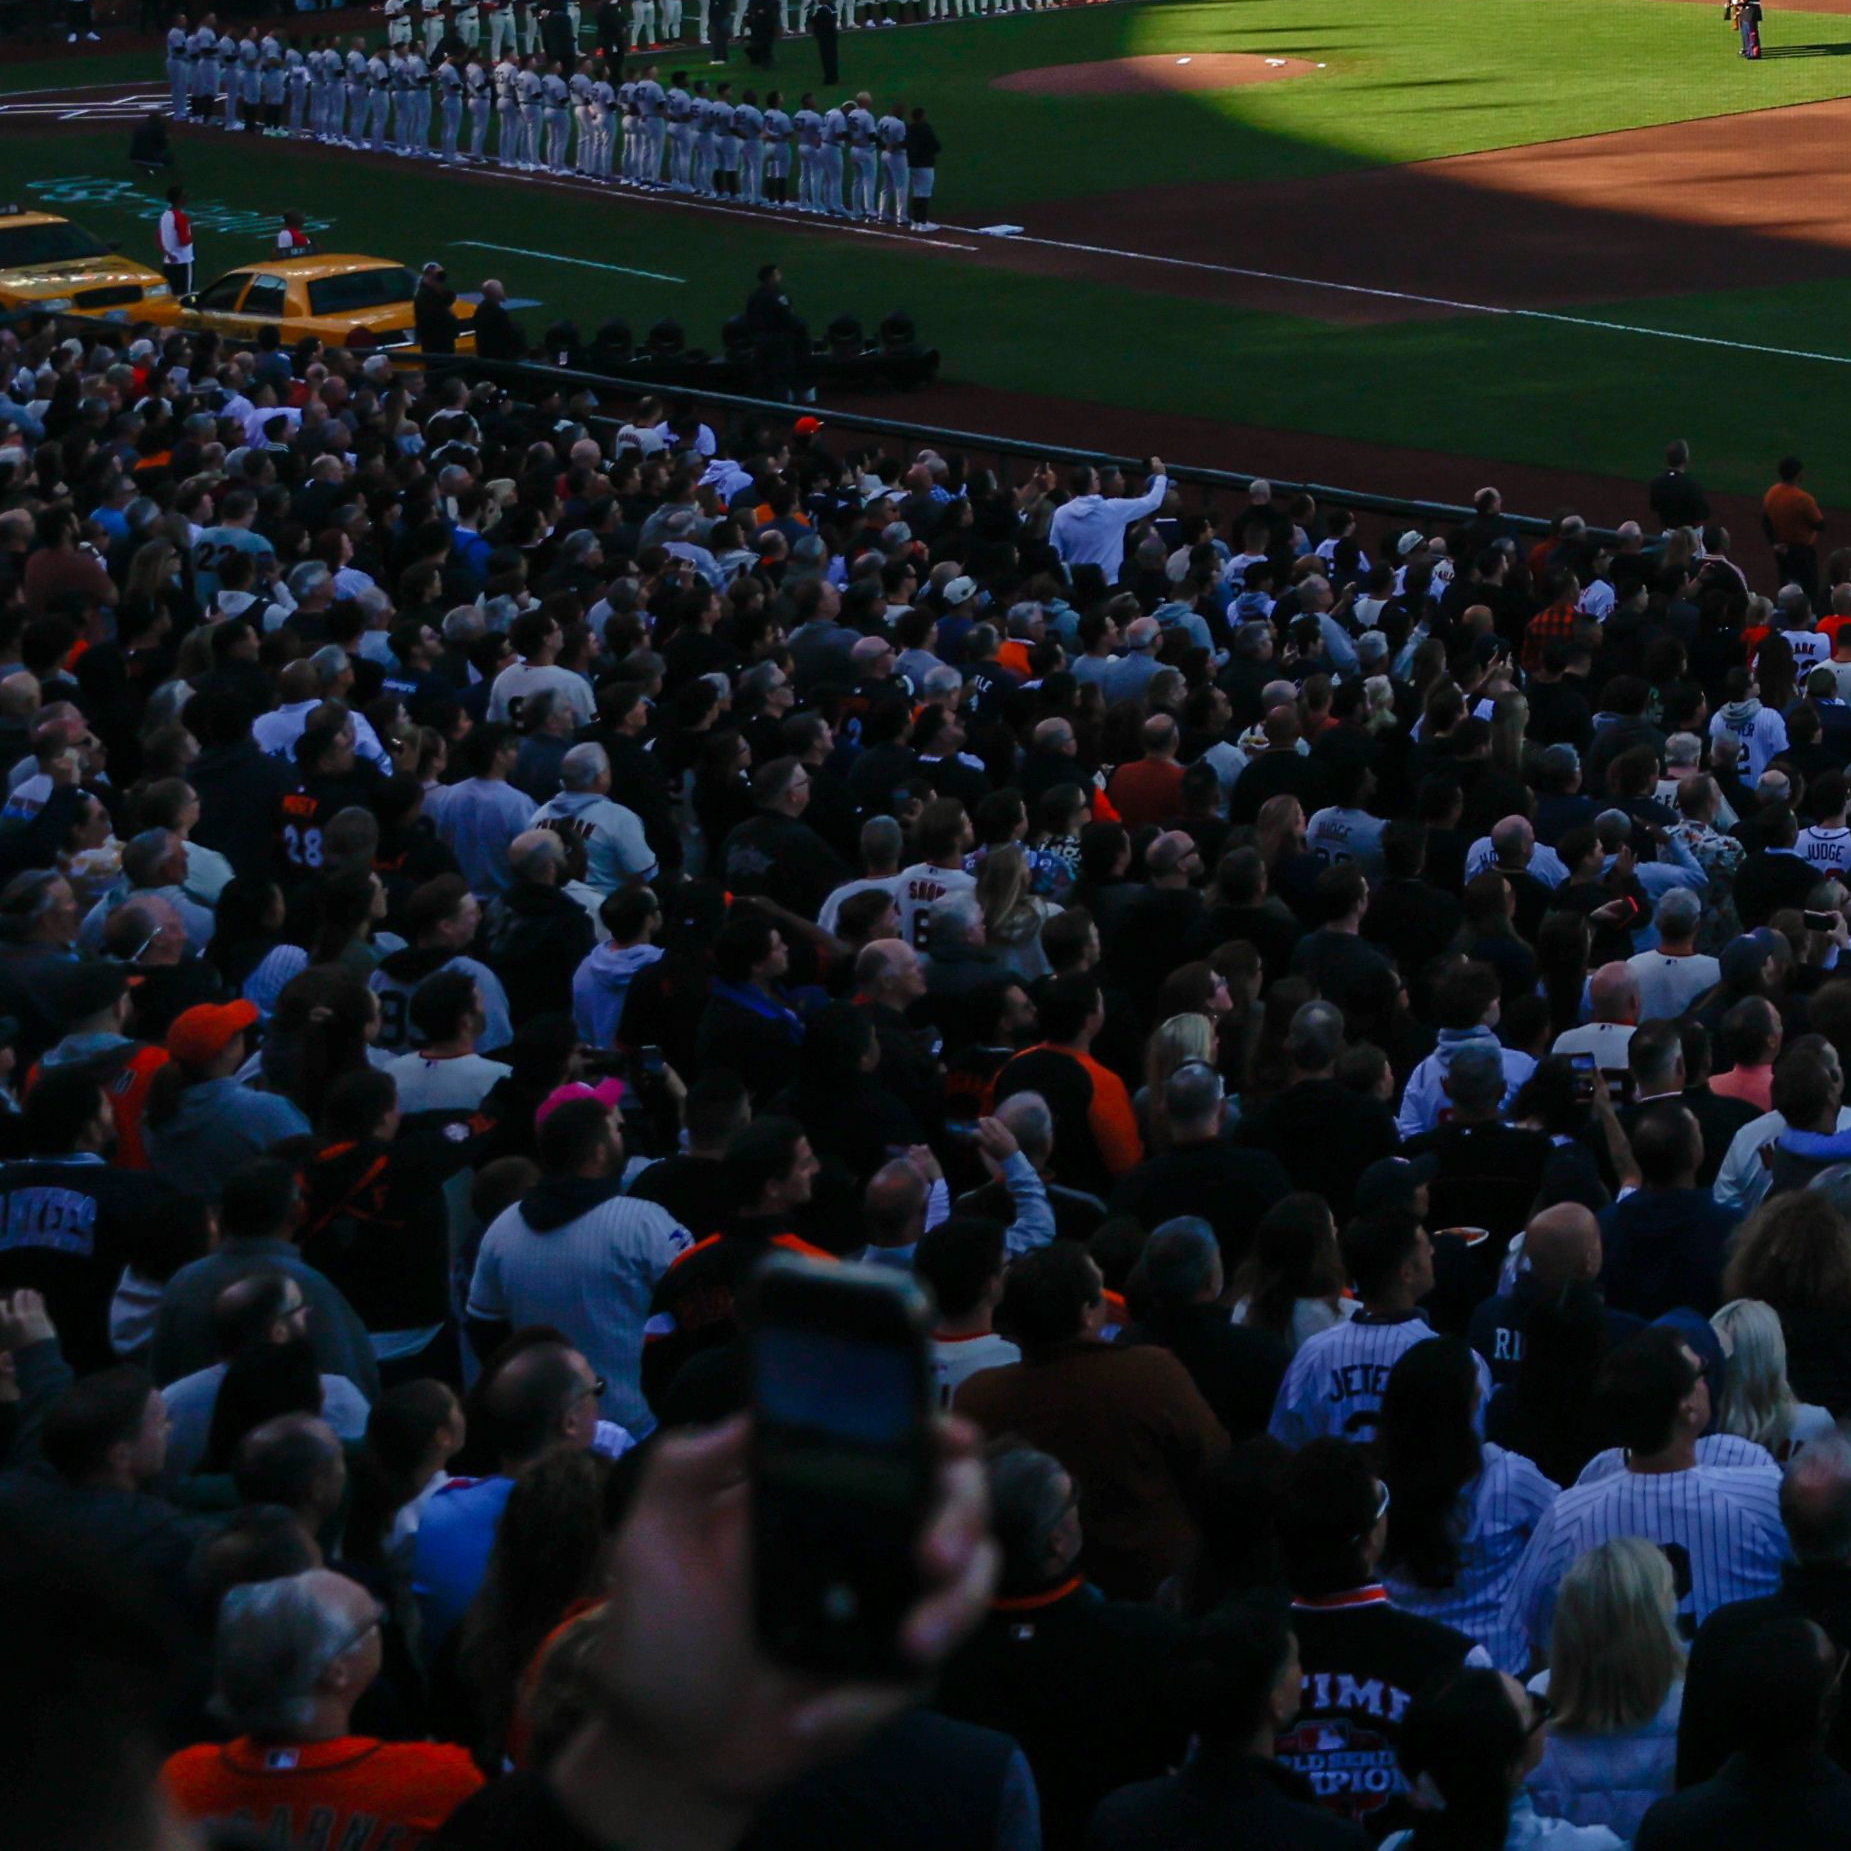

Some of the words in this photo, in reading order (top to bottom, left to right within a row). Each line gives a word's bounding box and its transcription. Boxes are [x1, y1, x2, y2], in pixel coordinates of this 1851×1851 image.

[284, 823, 324, 867] 28
[1807, 843, 1844, 863] JUDGE
[1329, 1363, 1391, 1405] JETE
